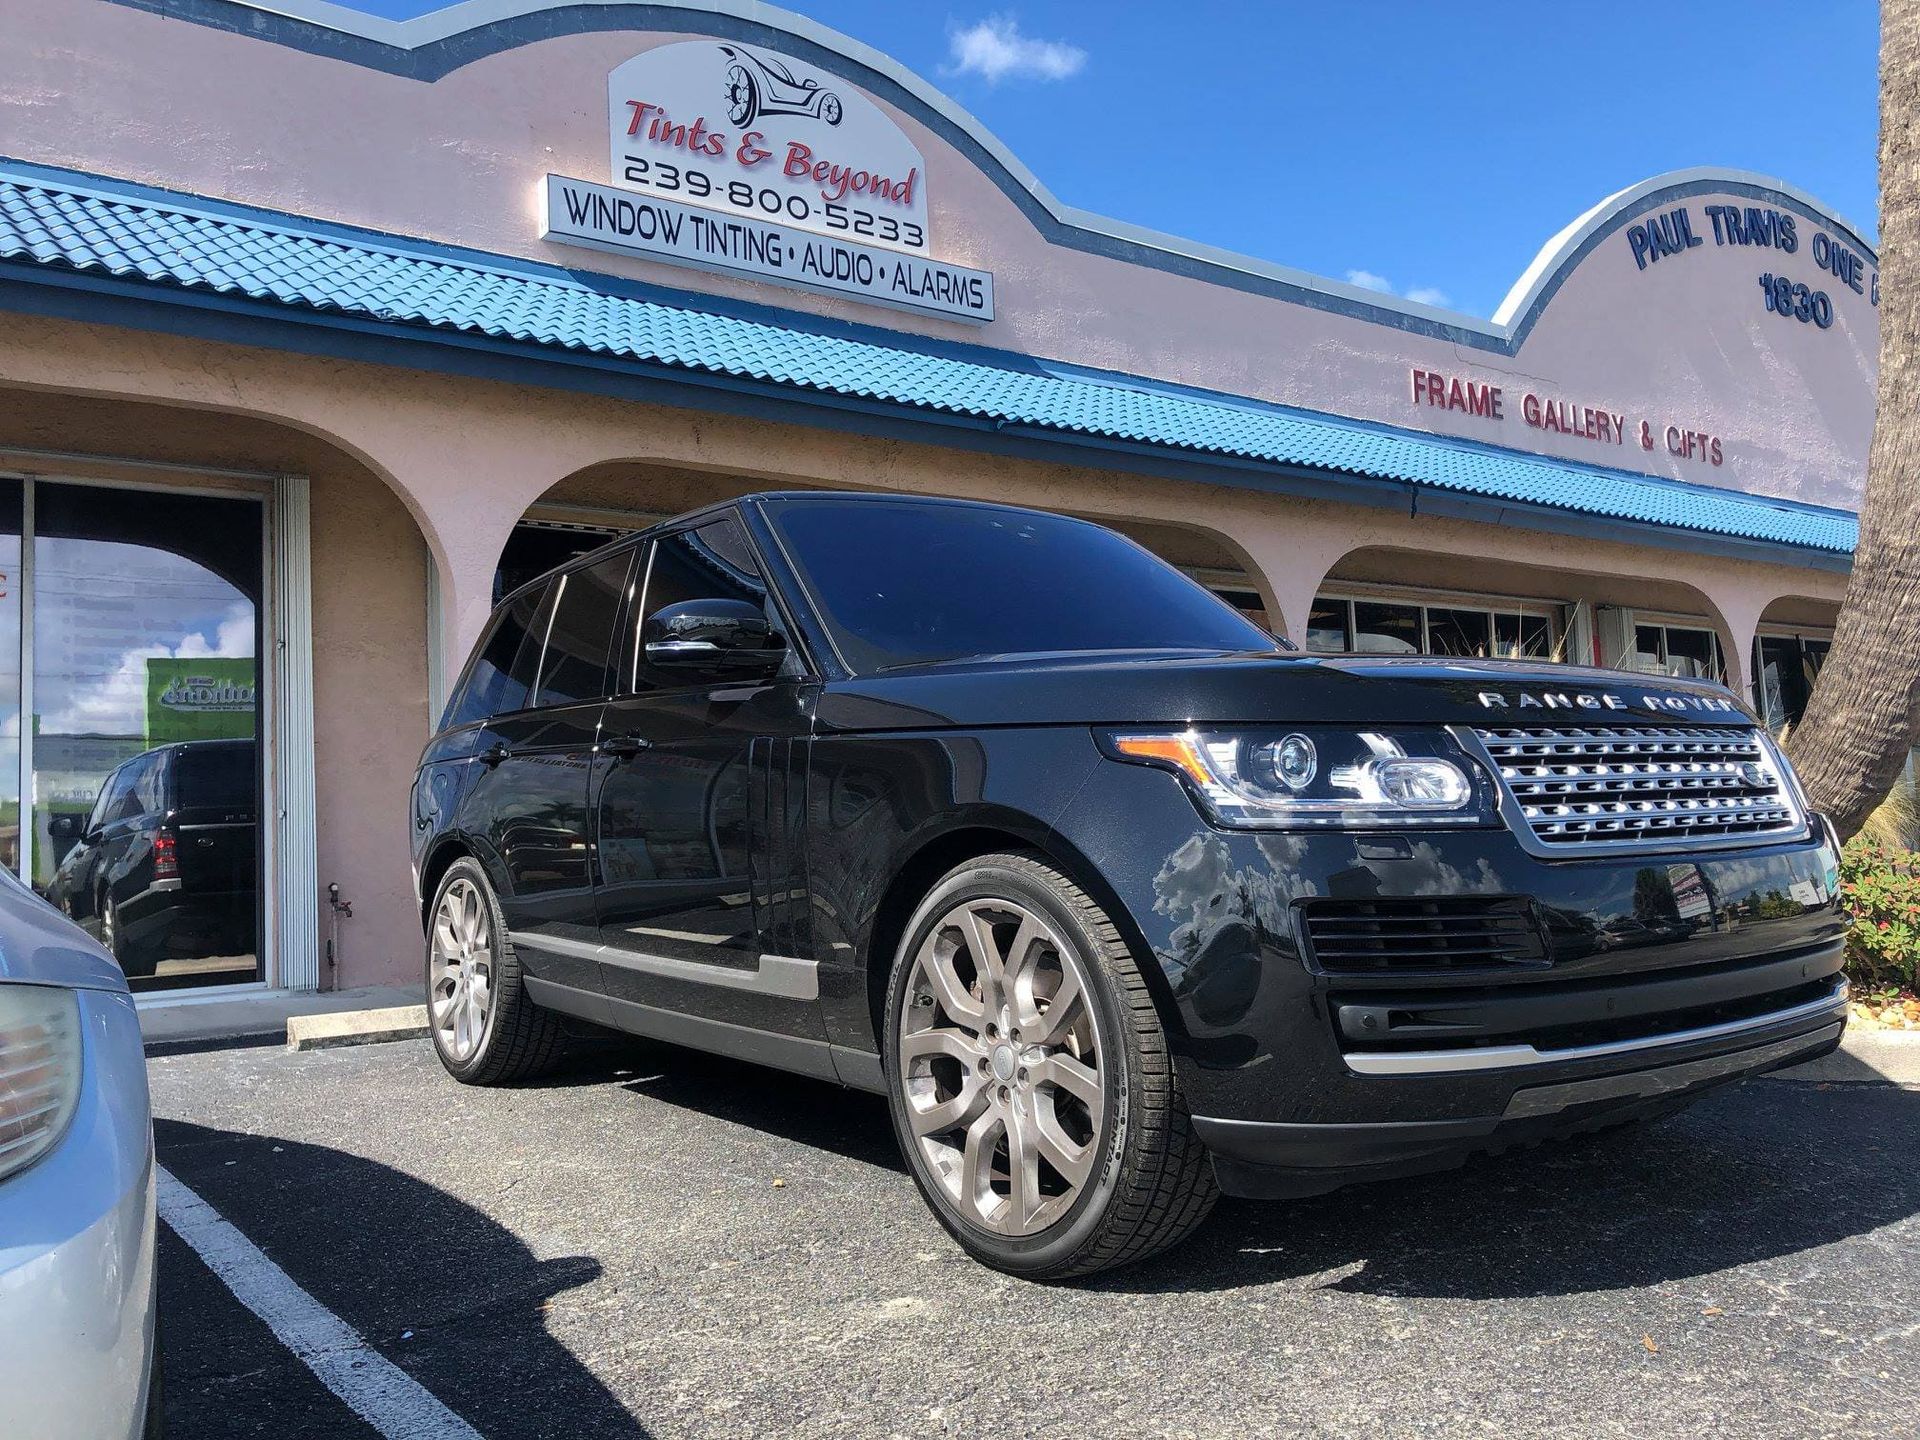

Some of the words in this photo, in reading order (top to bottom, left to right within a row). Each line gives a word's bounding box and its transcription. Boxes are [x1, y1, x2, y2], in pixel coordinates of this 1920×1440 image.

[626, 100, 725, 156] Tints
[737, 131, 772, 166] &
[783, 142, 916, 204] Beyond
[624, 154, 924, 248] 239-800-5233
[563, 187, 684, 246] WINDOW
[690, 215, 782, 267] TINTING
[802, 242, 873, 286] AUDIO
[892, 261, 984, 309] ALARMS
[1627, 207, 1703, 270] PAUL
[1705, 205, 1798, 254] TRAVIS
[1812, 232, 1864, 295] ONE
[1759, 272, 1833, 329] 1830
[1411, 369, 1504, 420] FRAME
[1521, 393, 1624, 445] GALLERY
[1640, 420, 1654, 452] &
[1478, 692, 1627, 710] RANGE
[1642, 696, 1737, 713] ROVER
